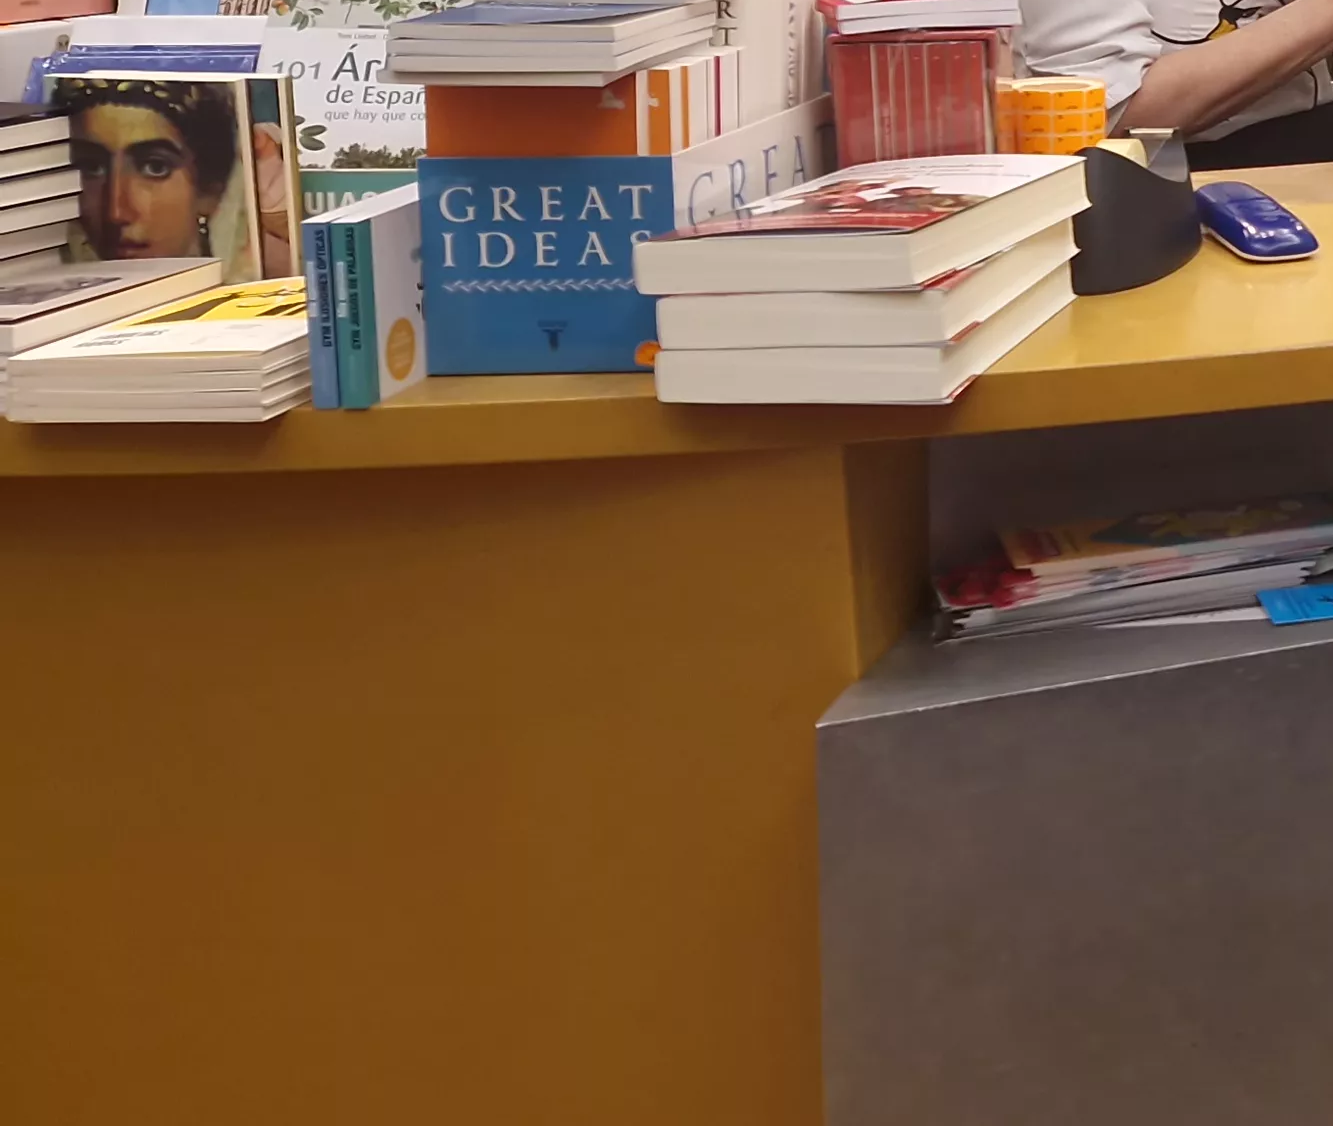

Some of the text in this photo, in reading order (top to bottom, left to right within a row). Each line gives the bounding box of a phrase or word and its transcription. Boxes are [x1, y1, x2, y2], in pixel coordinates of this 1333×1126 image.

[271, 60, 322, 80] 101
[326, 85, 354, 105] de
[324, 109, 406, 123] que hay que
[438, 184, 653, 222] GREAT
[322, 323, 332, 348] GYM
[350, 327, 360, 351] GYM
